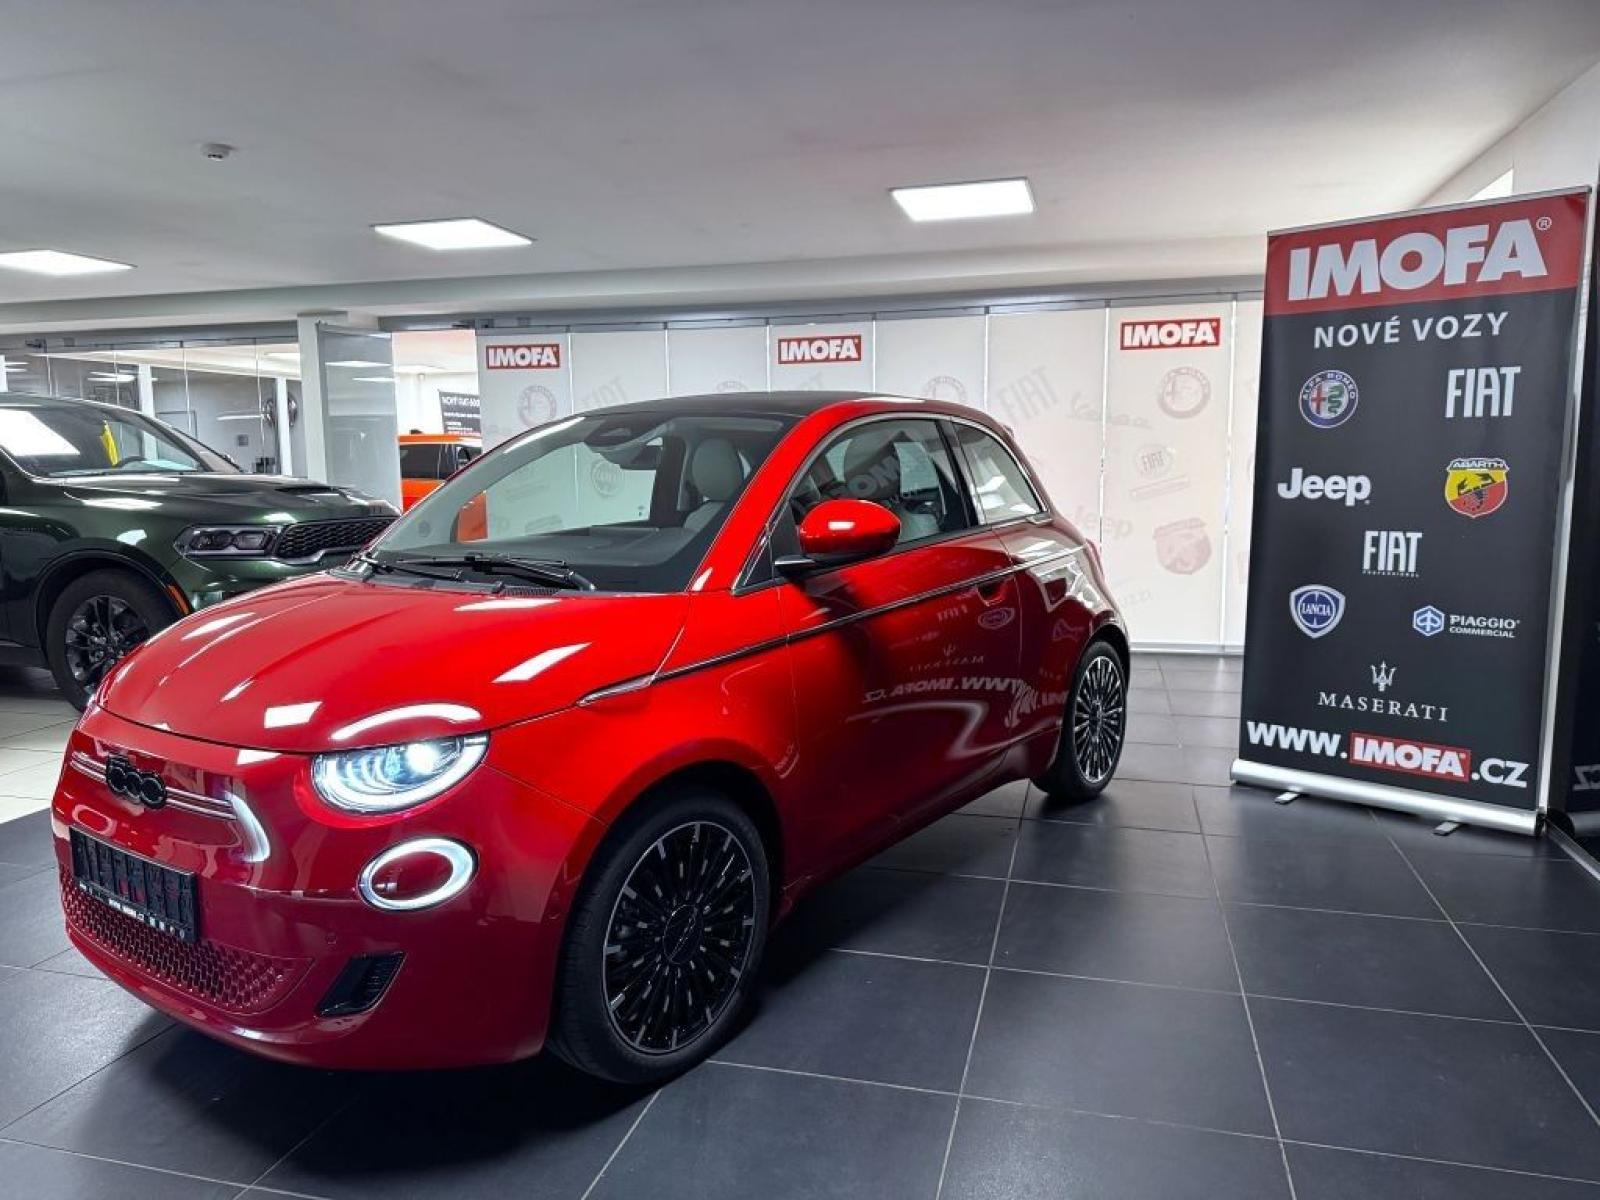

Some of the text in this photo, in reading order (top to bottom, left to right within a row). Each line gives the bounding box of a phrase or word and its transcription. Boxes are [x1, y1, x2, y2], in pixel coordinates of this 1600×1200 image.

[1123, 321, 1218, 347] IMOFA
[1313, 312, 1509, 349] NOVÉ VOZY
[487, 346, 558, 368] IMOFA
[779, 337, 859, 362] IMOFA
[1445, 366, 1521, 418] FIAT
[1277, 467, 1371, 507] Jeep
[1363, 530, 1423, 573] FIAT
[1301, 602, 1332, 617] LANCIA
[1449, 614, 1516, 629] PIAGGIO
[1449, 626, 1515, 638] COMMERCIAL
[1317, 691, 1449, 722] MASERATI
